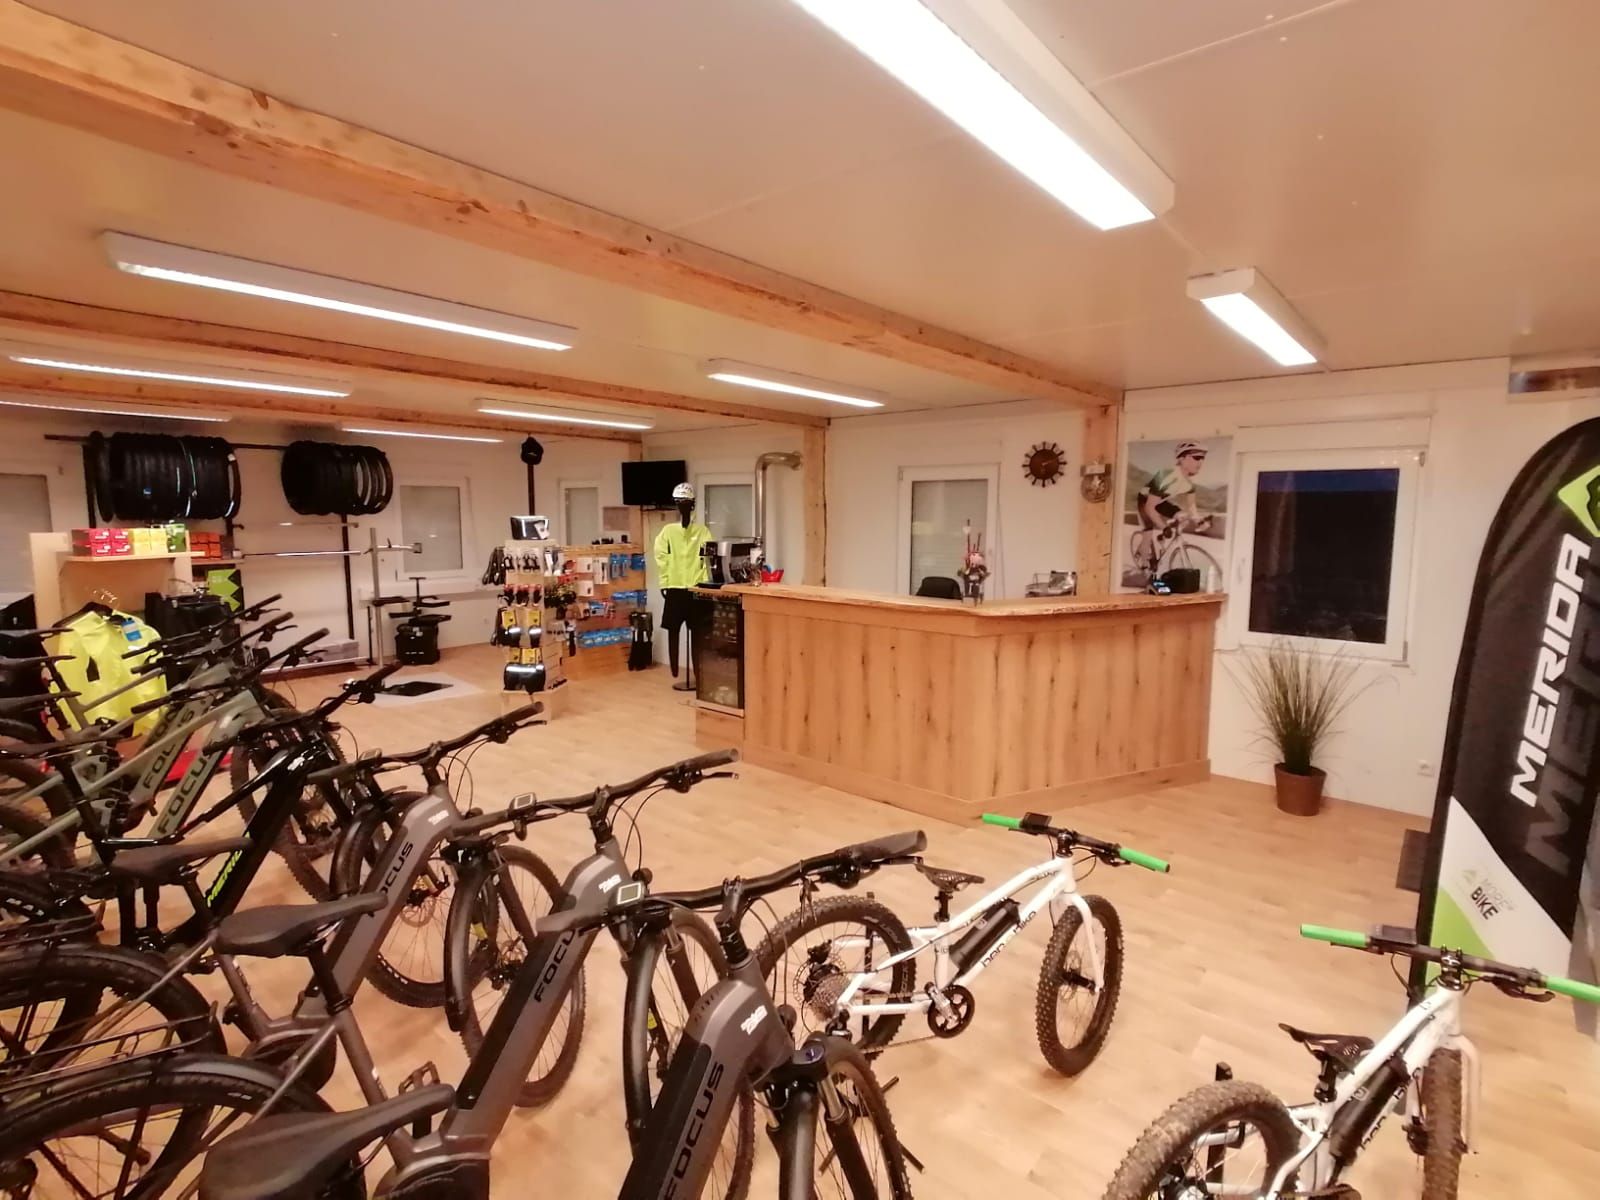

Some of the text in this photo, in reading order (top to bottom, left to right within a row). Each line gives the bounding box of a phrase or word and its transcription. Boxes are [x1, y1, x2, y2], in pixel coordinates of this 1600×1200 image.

[1510, 533, 1592, 808] MERIDA
[157, 738, 213, 834] FOCU
[1470, 886, 1499, 921] BIKE
[534, 929, 577, 1002] FOCU
